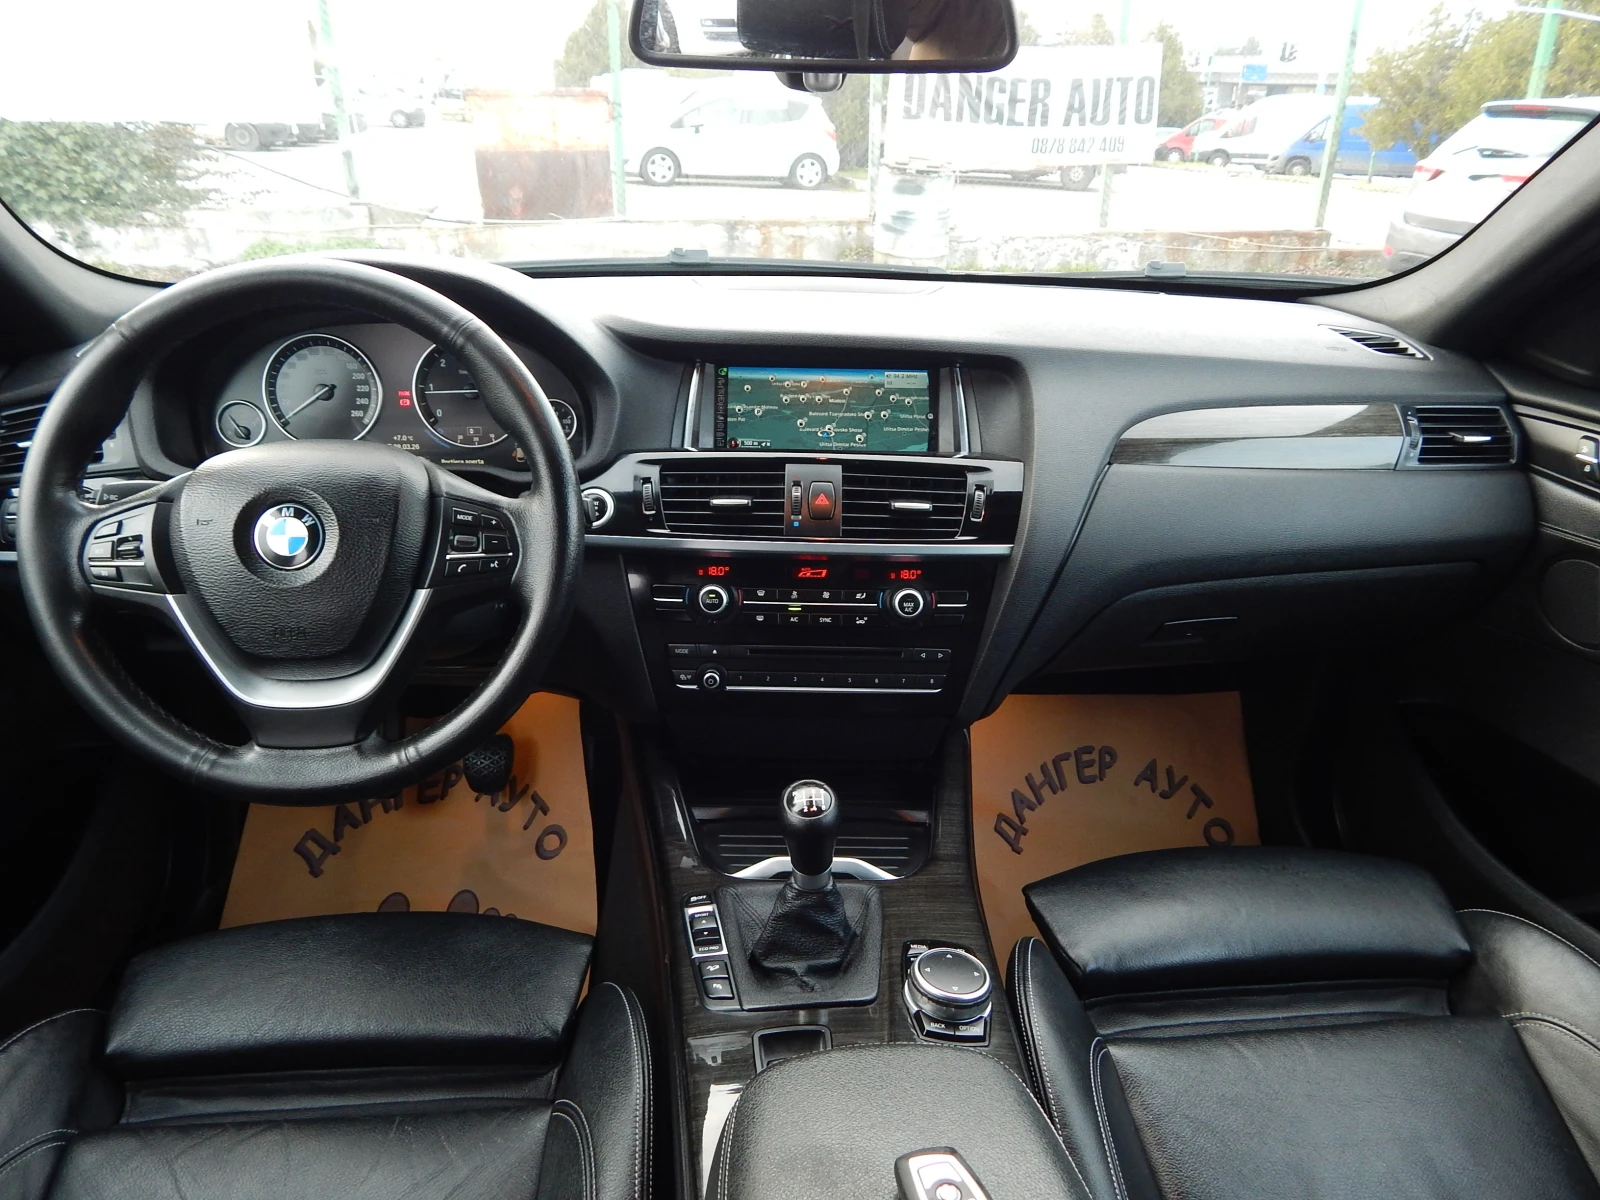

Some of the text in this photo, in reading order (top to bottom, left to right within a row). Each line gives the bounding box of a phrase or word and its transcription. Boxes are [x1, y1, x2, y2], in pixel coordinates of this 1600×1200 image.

[903, 74, 1155, 127] DANGER AUTO
[1069, 137, 1095, 154] 842
[1099, 136, 1125, 152] 409
[440, 359, 446, 368] 2
[352, 372, 365, 380] 200
[356, 384, 370, 393] 220
[436, 409, 442, 417] 0
[993, 745, 1234, 855] ДАНГЕР АУТО
[930, 1021, 946, 1029] BACK
[959, 1024, 979, 1032] OPTION
